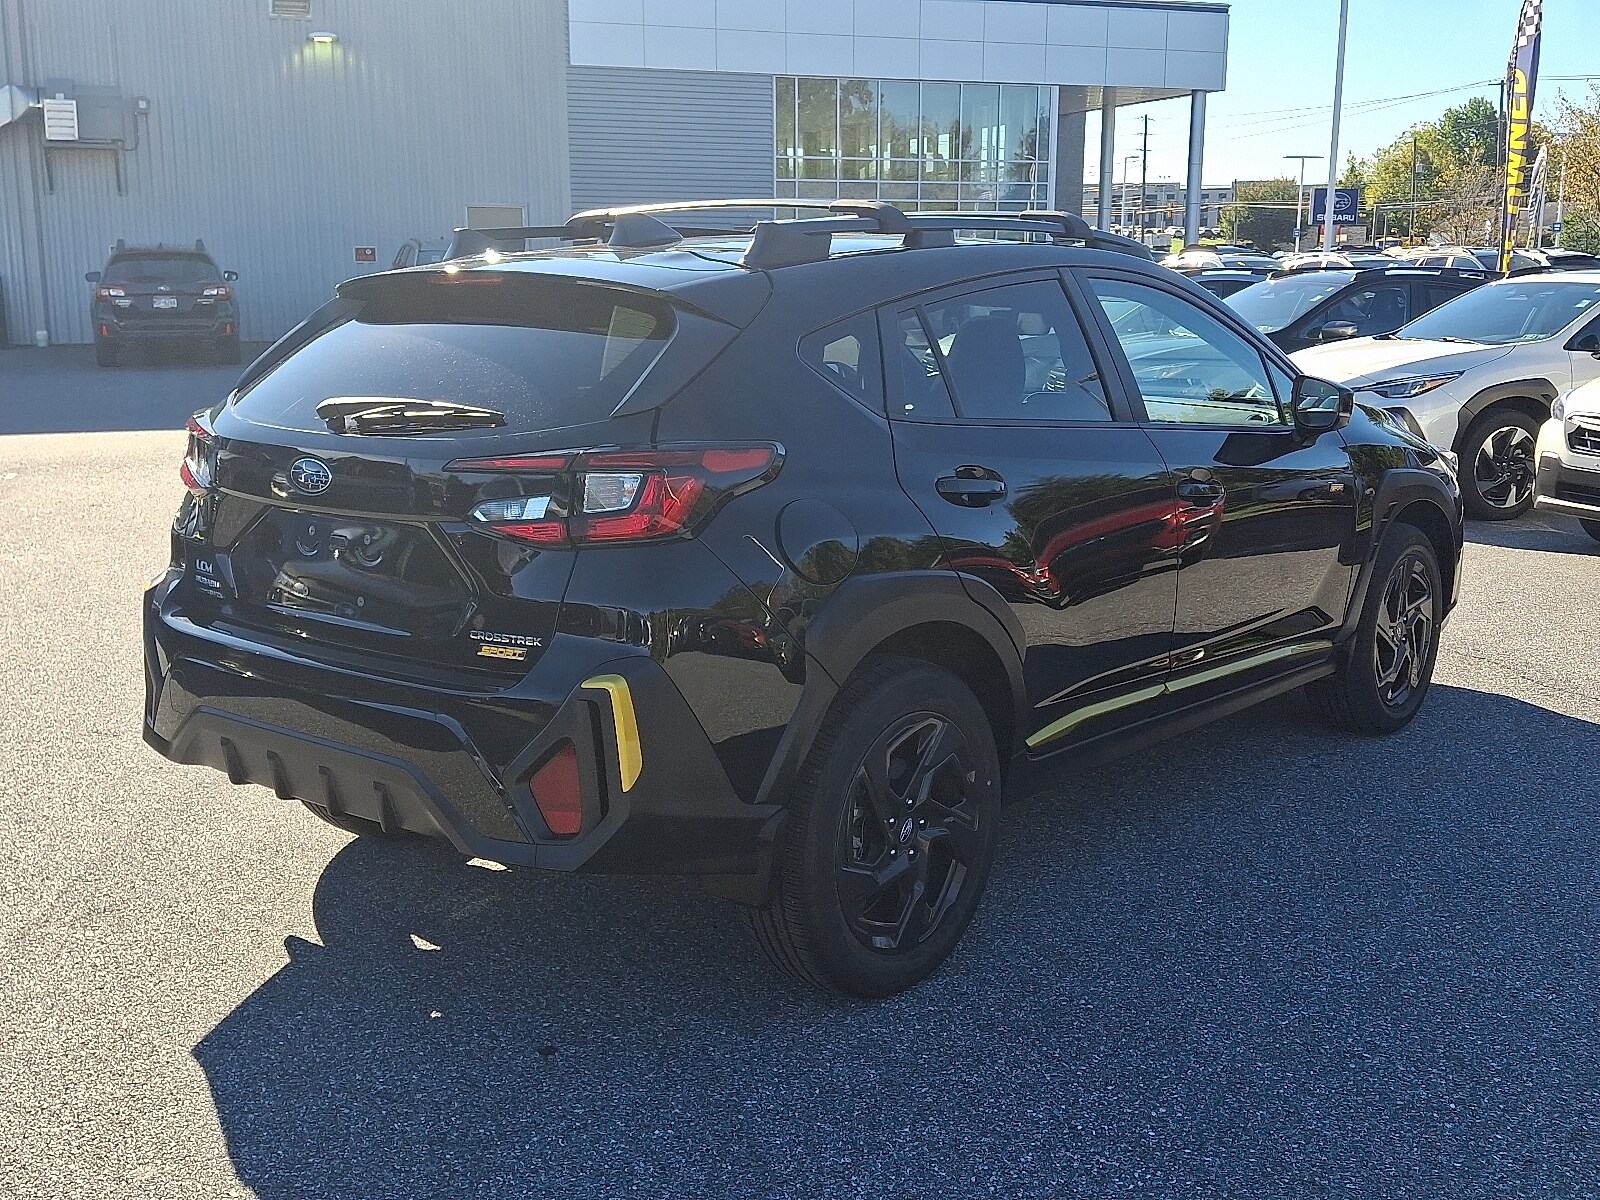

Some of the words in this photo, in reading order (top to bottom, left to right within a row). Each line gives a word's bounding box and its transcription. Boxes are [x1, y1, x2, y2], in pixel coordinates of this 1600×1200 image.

[1316, 213, 1355, 221] SBARU
[469, 630, 543, 647] CROSSTREK
[480, 646, 525, 659] SPORT
